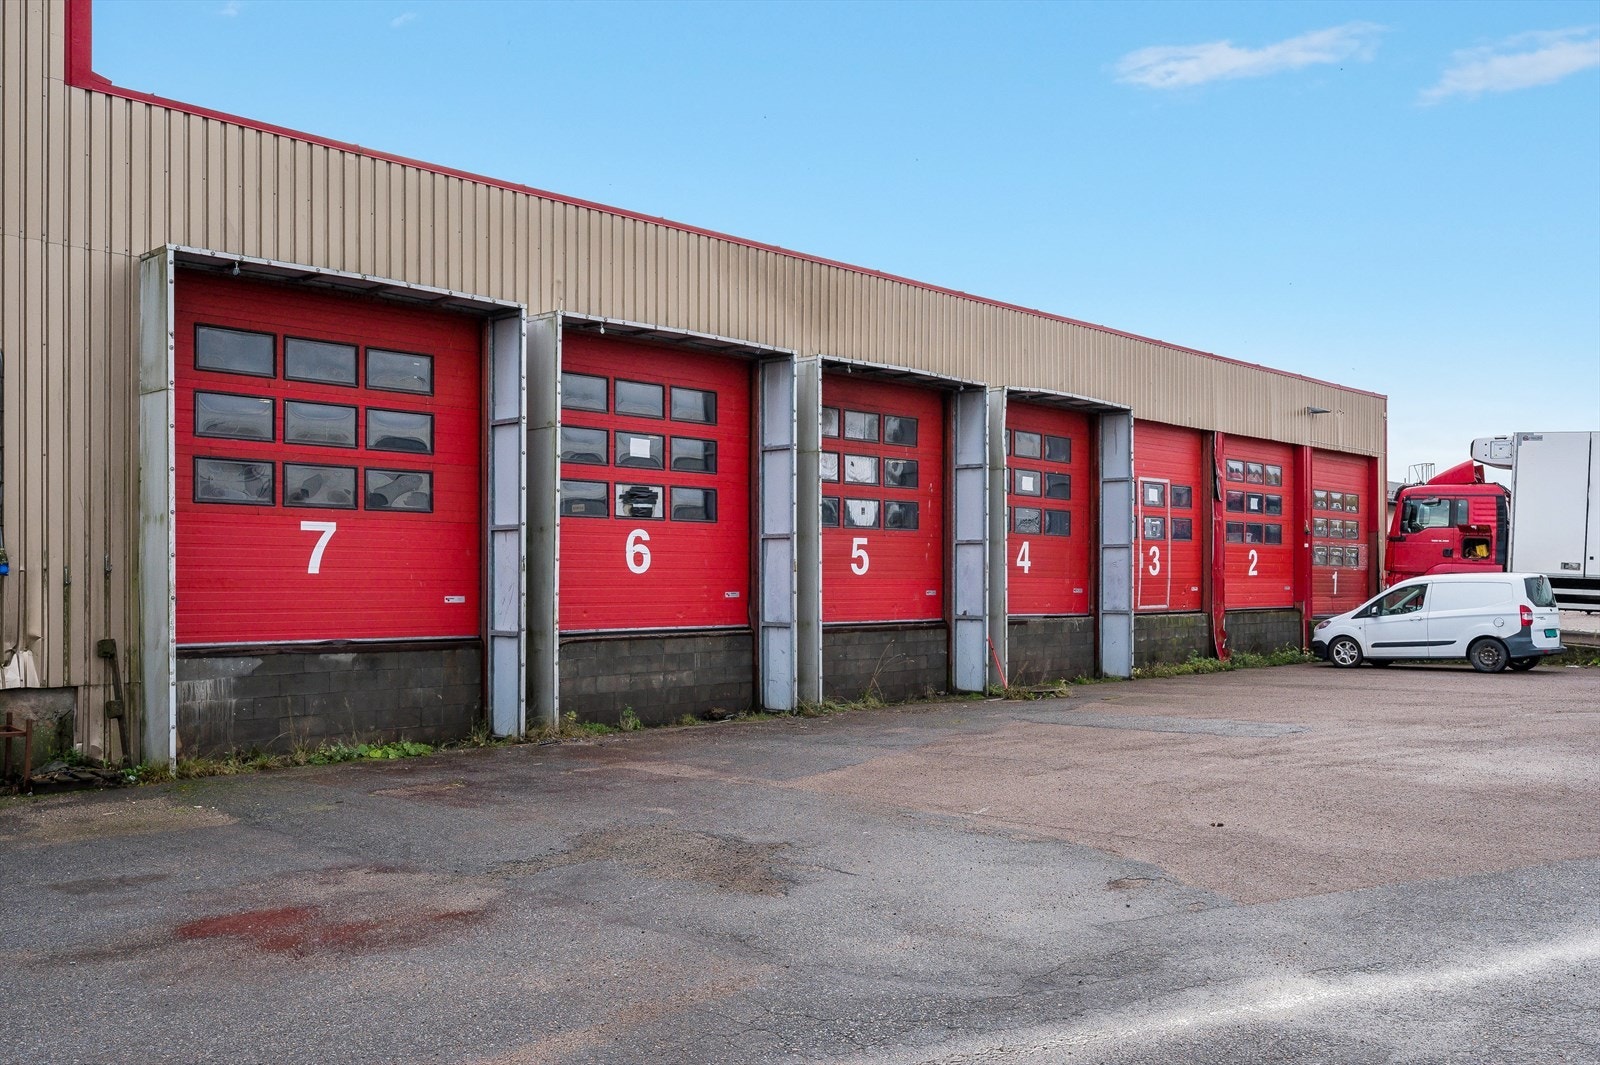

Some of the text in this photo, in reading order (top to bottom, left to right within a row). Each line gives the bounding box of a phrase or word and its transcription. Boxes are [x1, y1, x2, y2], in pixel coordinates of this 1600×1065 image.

[300, 520, 336, 574] 7
[625, 528, 651, 575] 6
[850, 537, 869, 576] 5
[1016, 541, 1032, 574] 4
[1148, 545, 1160, 576] 3
[1248, 549, 1258, 576] 2
[1332, 571, 1338, 594] 1
